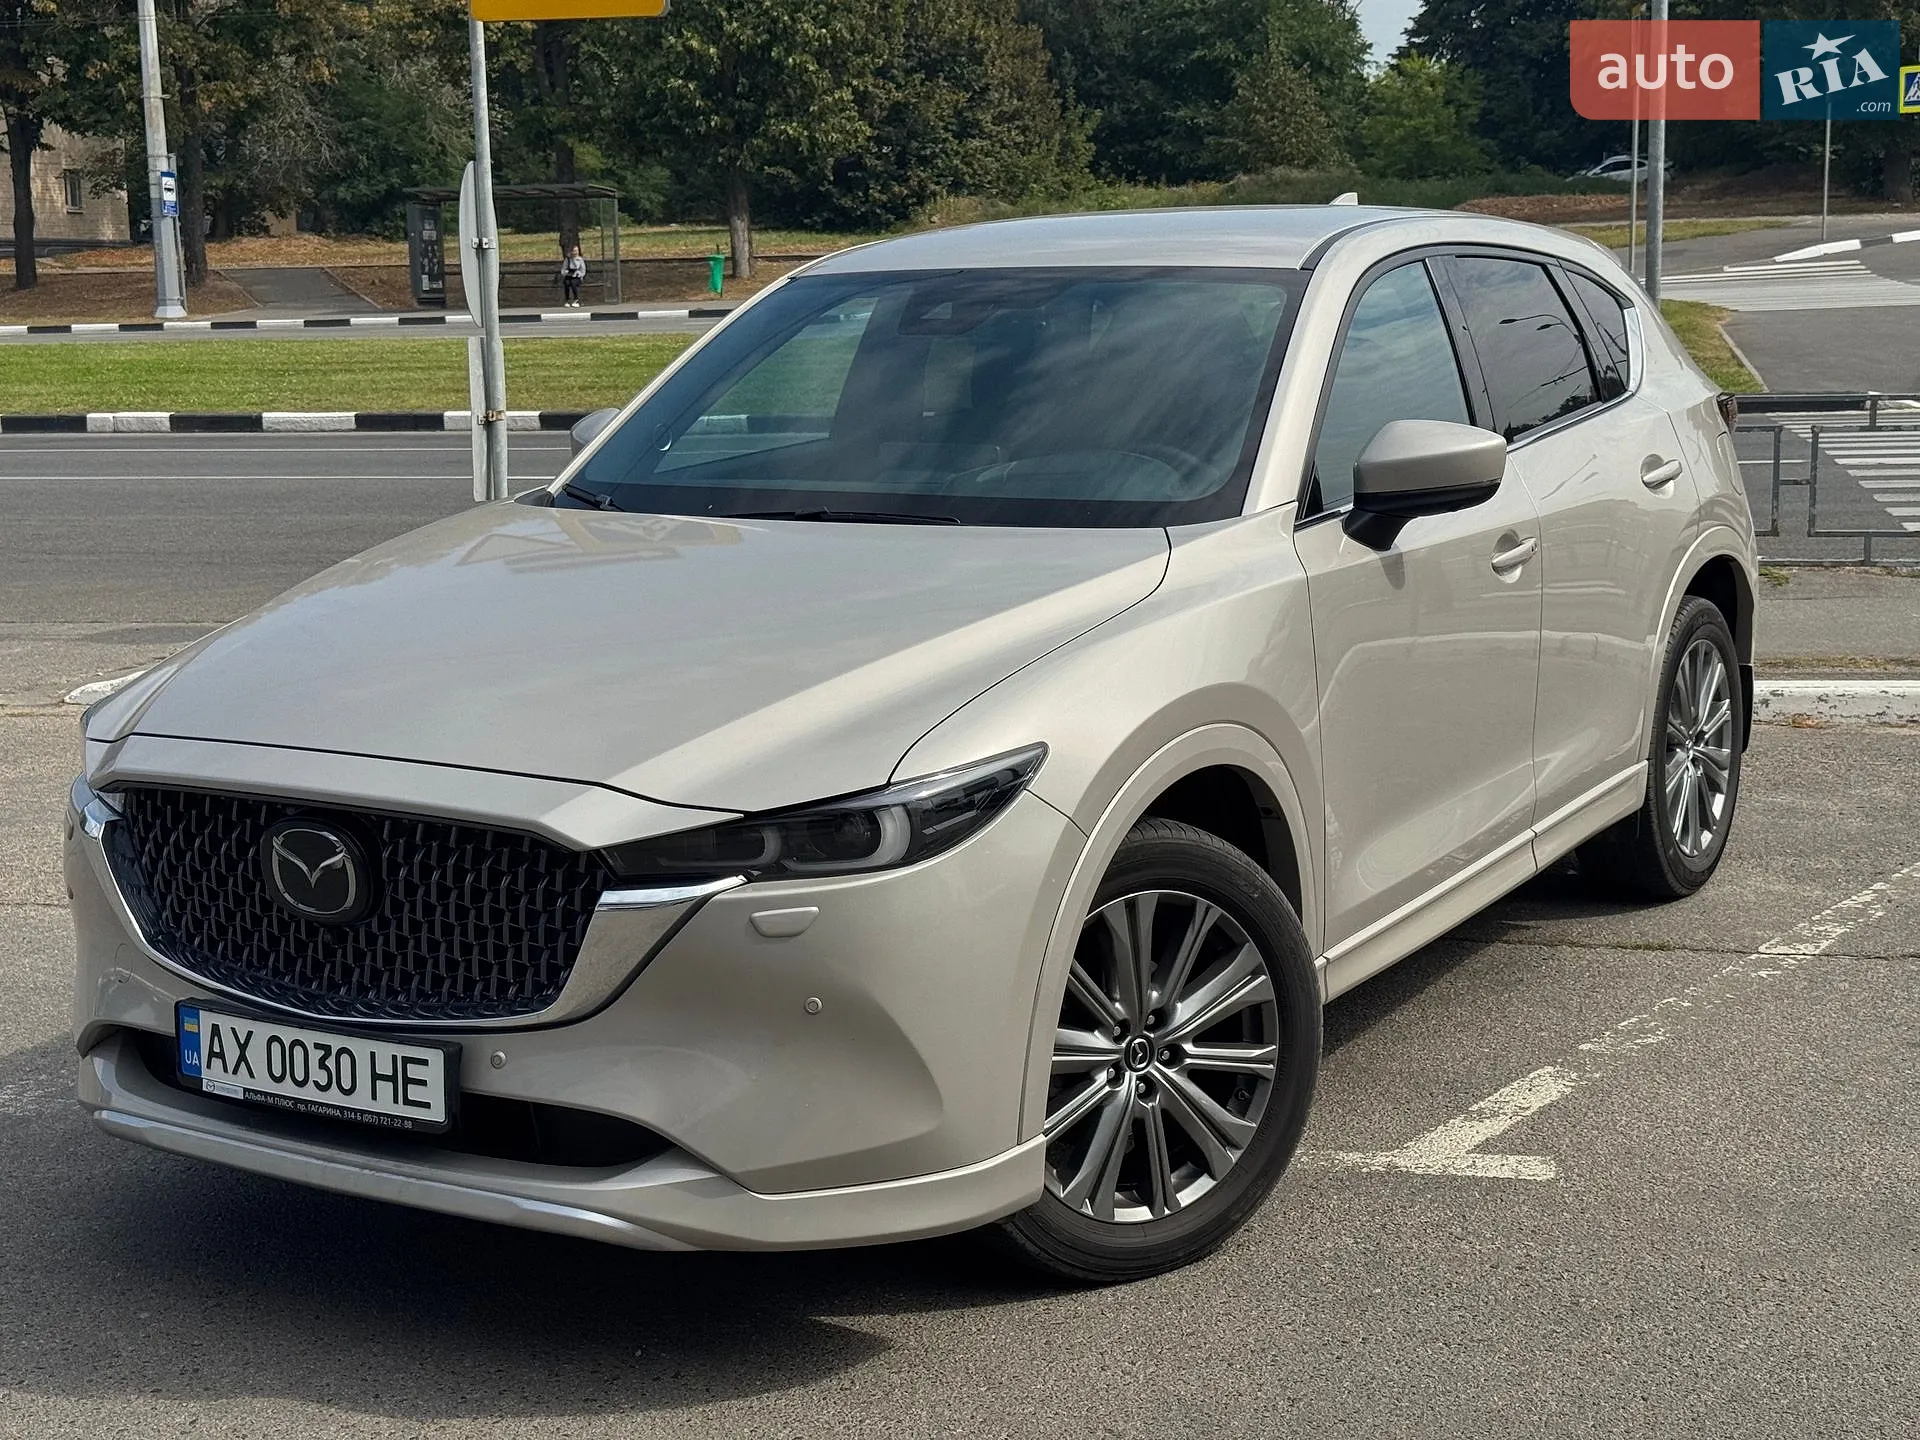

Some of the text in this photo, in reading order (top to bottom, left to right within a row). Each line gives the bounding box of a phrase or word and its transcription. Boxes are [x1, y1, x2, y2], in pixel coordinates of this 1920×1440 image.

[184, 1049, 200, 1066] UA
[206, 1023, 431, 1109] AX 0030 HE
[362, 1113, 379, 1125] (057)
